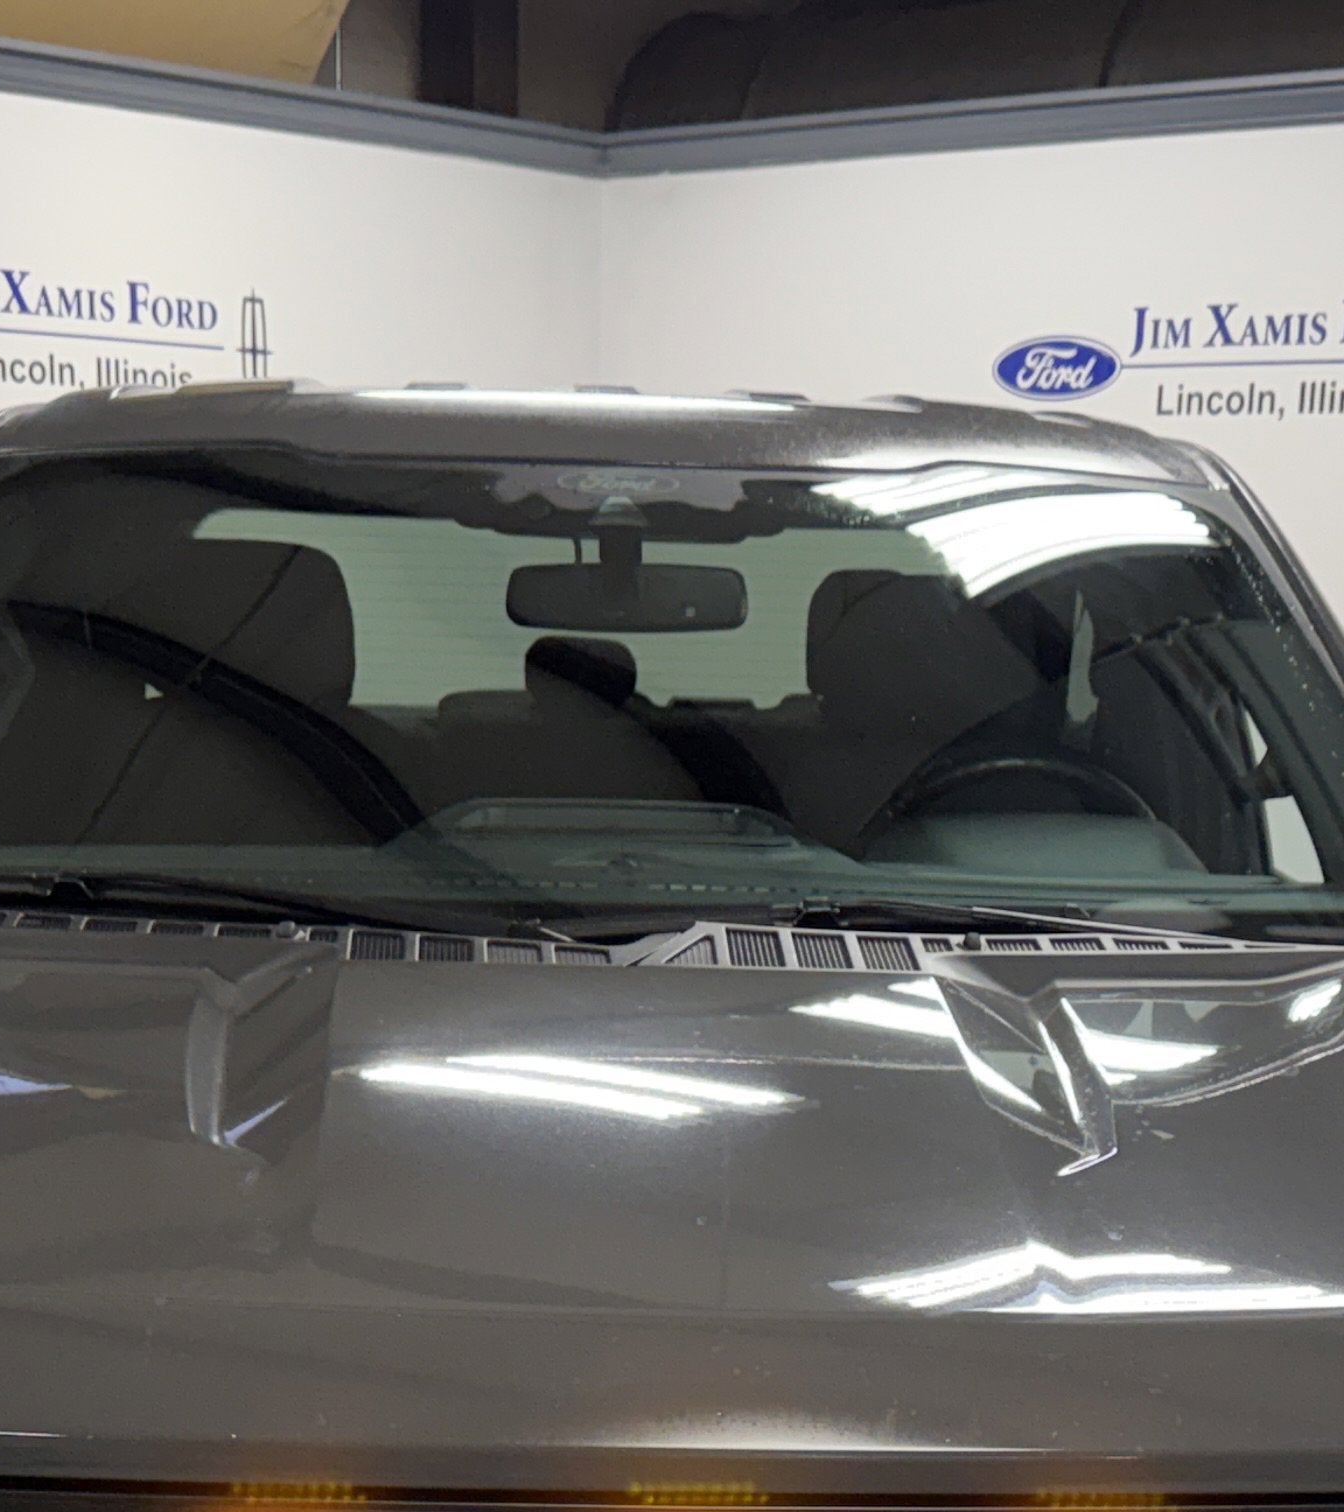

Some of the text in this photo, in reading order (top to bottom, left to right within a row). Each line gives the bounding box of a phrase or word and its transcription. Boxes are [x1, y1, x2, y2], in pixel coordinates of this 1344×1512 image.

[0, 269, 116, 321] XAMIS
[127, 281, 218, 330] FORD
[1130, 306, 1192, 357] JIM
[1204, 303, 1327, 348] XAMIS
[1016, 347, 1097, 390] Ford
[1156, 382, 1285, 421] Lincoln,
